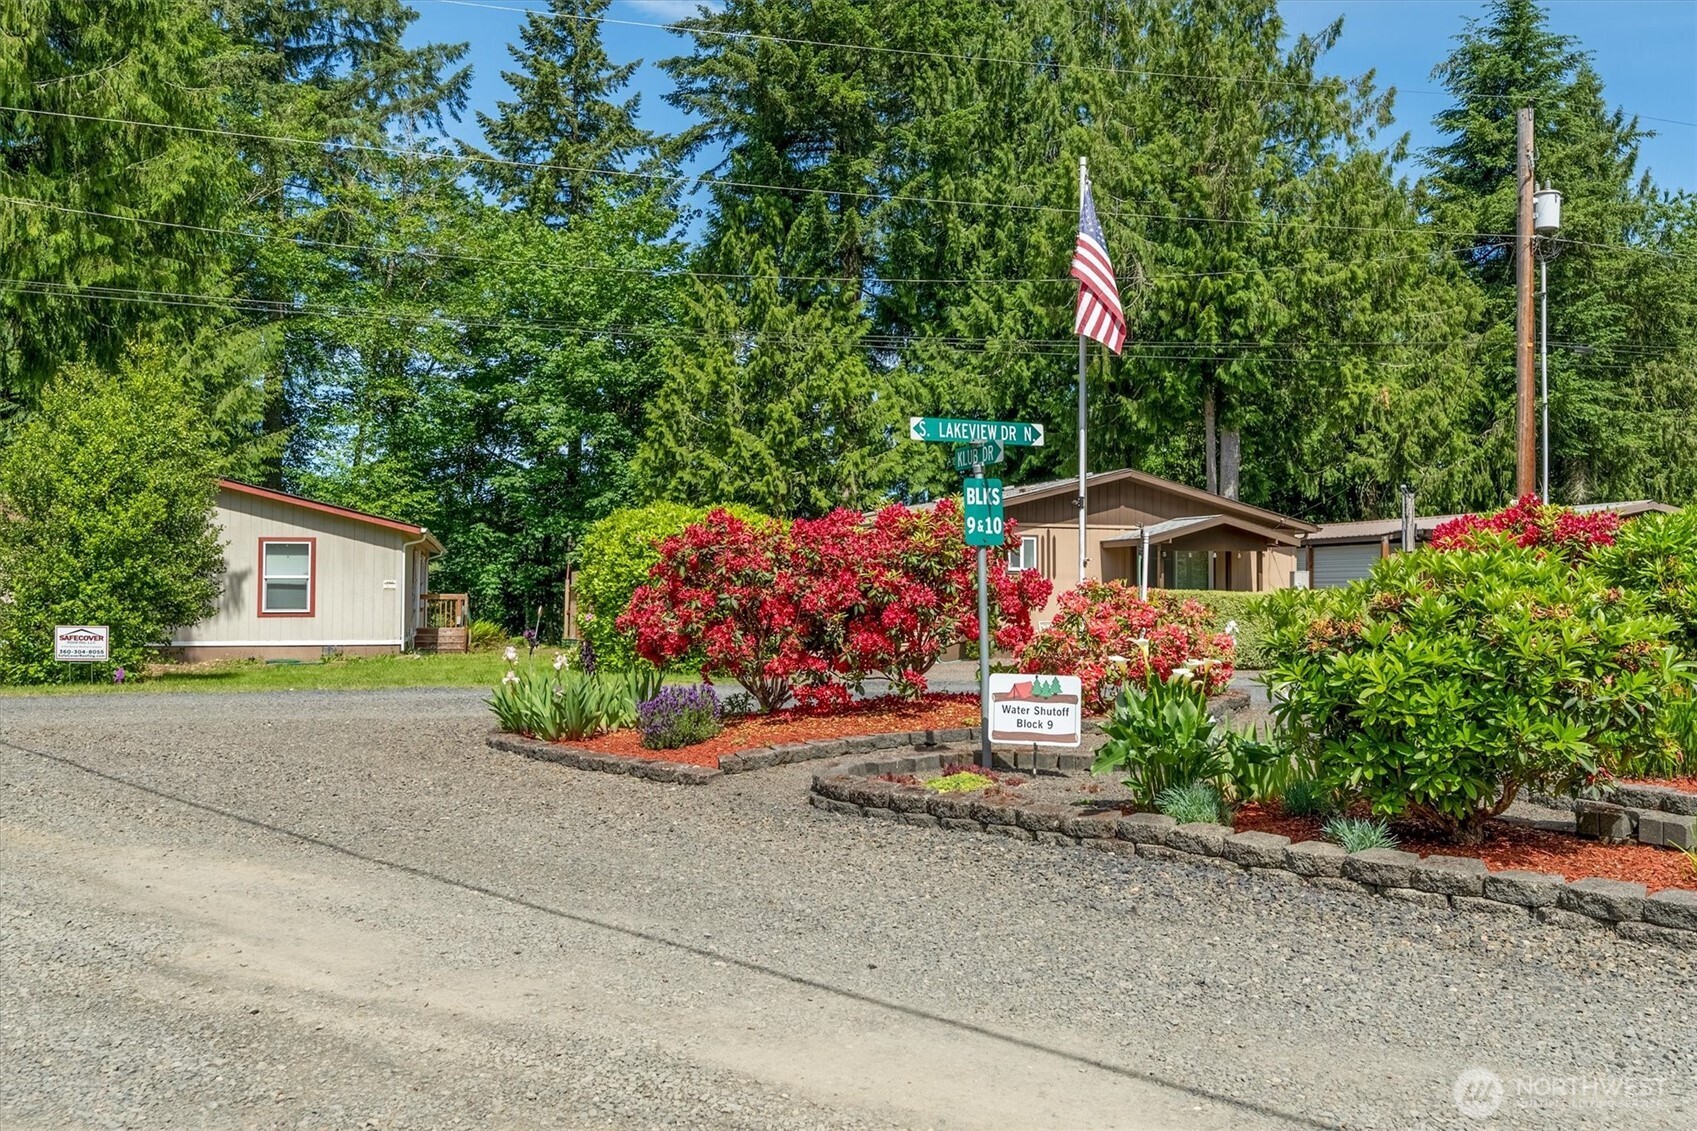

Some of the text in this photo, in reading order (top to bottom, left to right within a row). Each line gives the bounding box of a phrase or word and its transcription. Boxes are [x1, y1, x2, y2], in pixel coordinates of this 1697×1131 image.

[919, 421, 930, 437] S.
[939, 421, 997, 440] LAKEVIEW
[1001, 425, 1017, 441] DR
[957, 445, 994, 467] KLUB DR
[966, 487, 1001, 506] BLKS
[1001, 704, 1069, 716] Water Shutoff
[1016, 718, 1054, 730] Block 9
